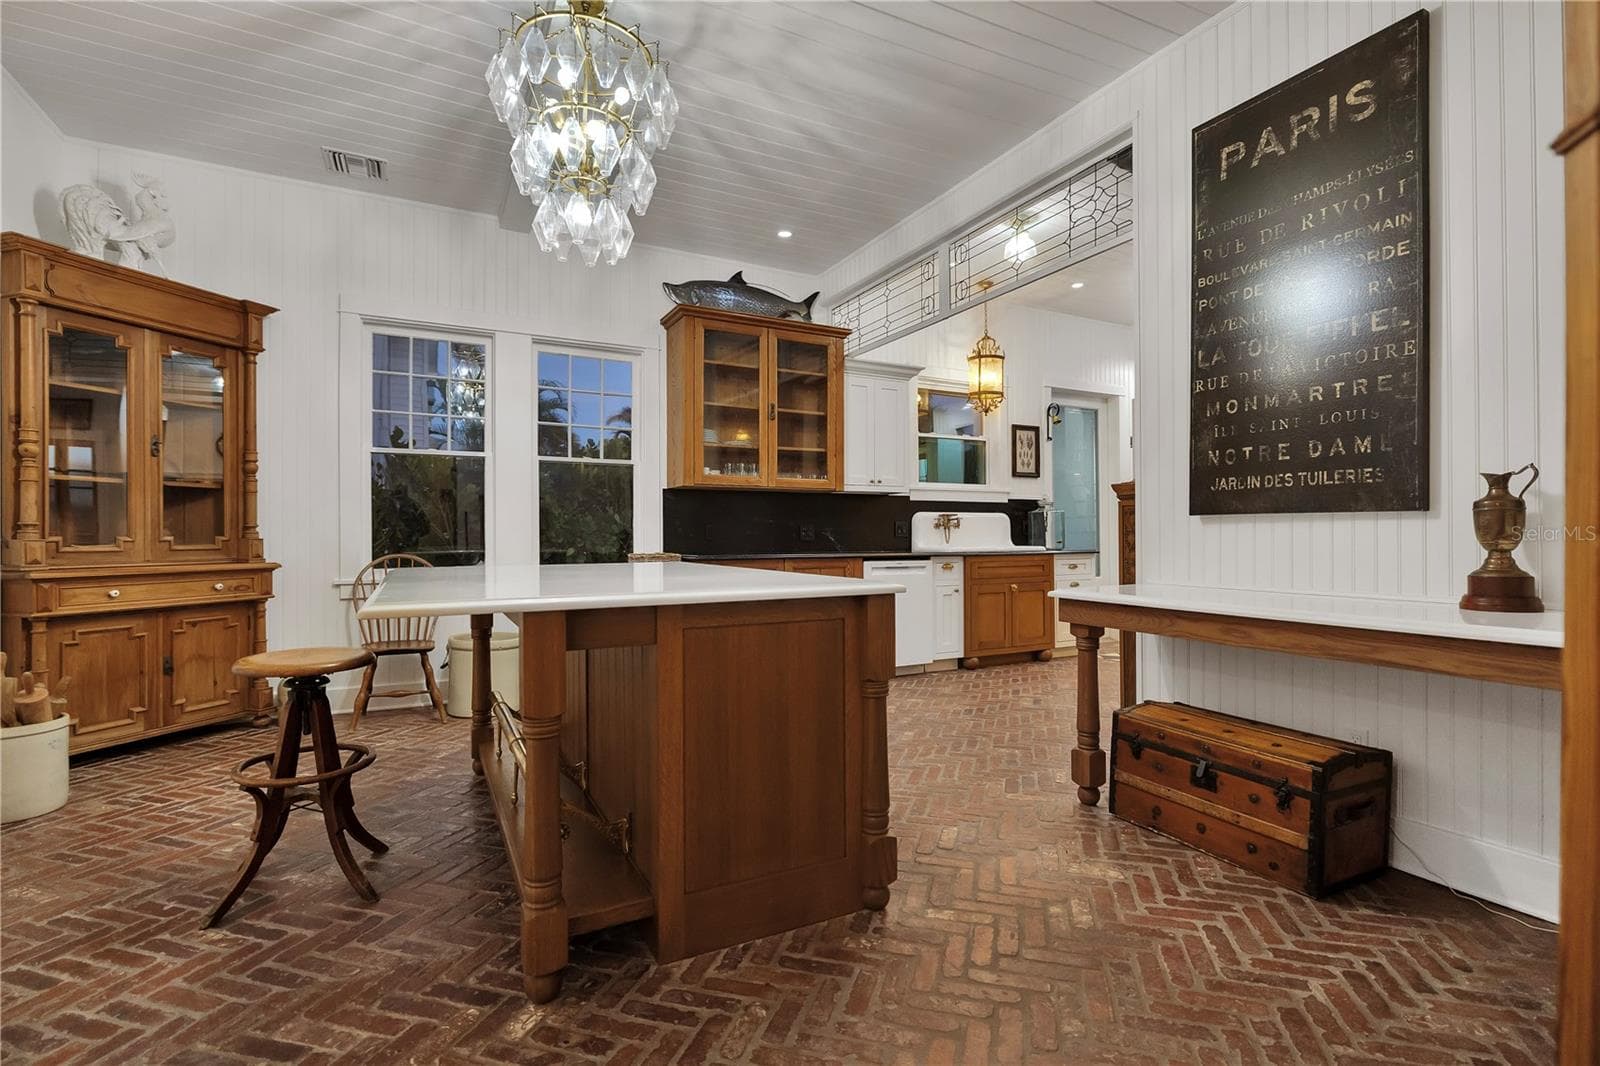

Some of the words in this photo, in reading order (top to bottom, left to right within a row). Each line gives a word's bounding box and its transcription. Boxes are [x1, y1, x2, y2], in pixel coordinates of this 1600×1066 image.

[1219, 79, 1377, 182] PARIS
[1203, 238, 1247, 262] RUE
[1260, 222, 1286, 245] DE
[1301, 178, 1407, 232] RIVOLI
[1243, 284, 1264, 301] DE
[1198, 346, 1226, 368] LA
[1194, 375, 1229, 394] RUE
[1239, 369, 1262, 385] DE
[1206, 374, 1393, 417] MONMARTRE
[1208, 443, 1290, 467] NOTRE
[1264, 472, 1294, 489] DES
[1297, 467, 1385, 487] TUILERIES
